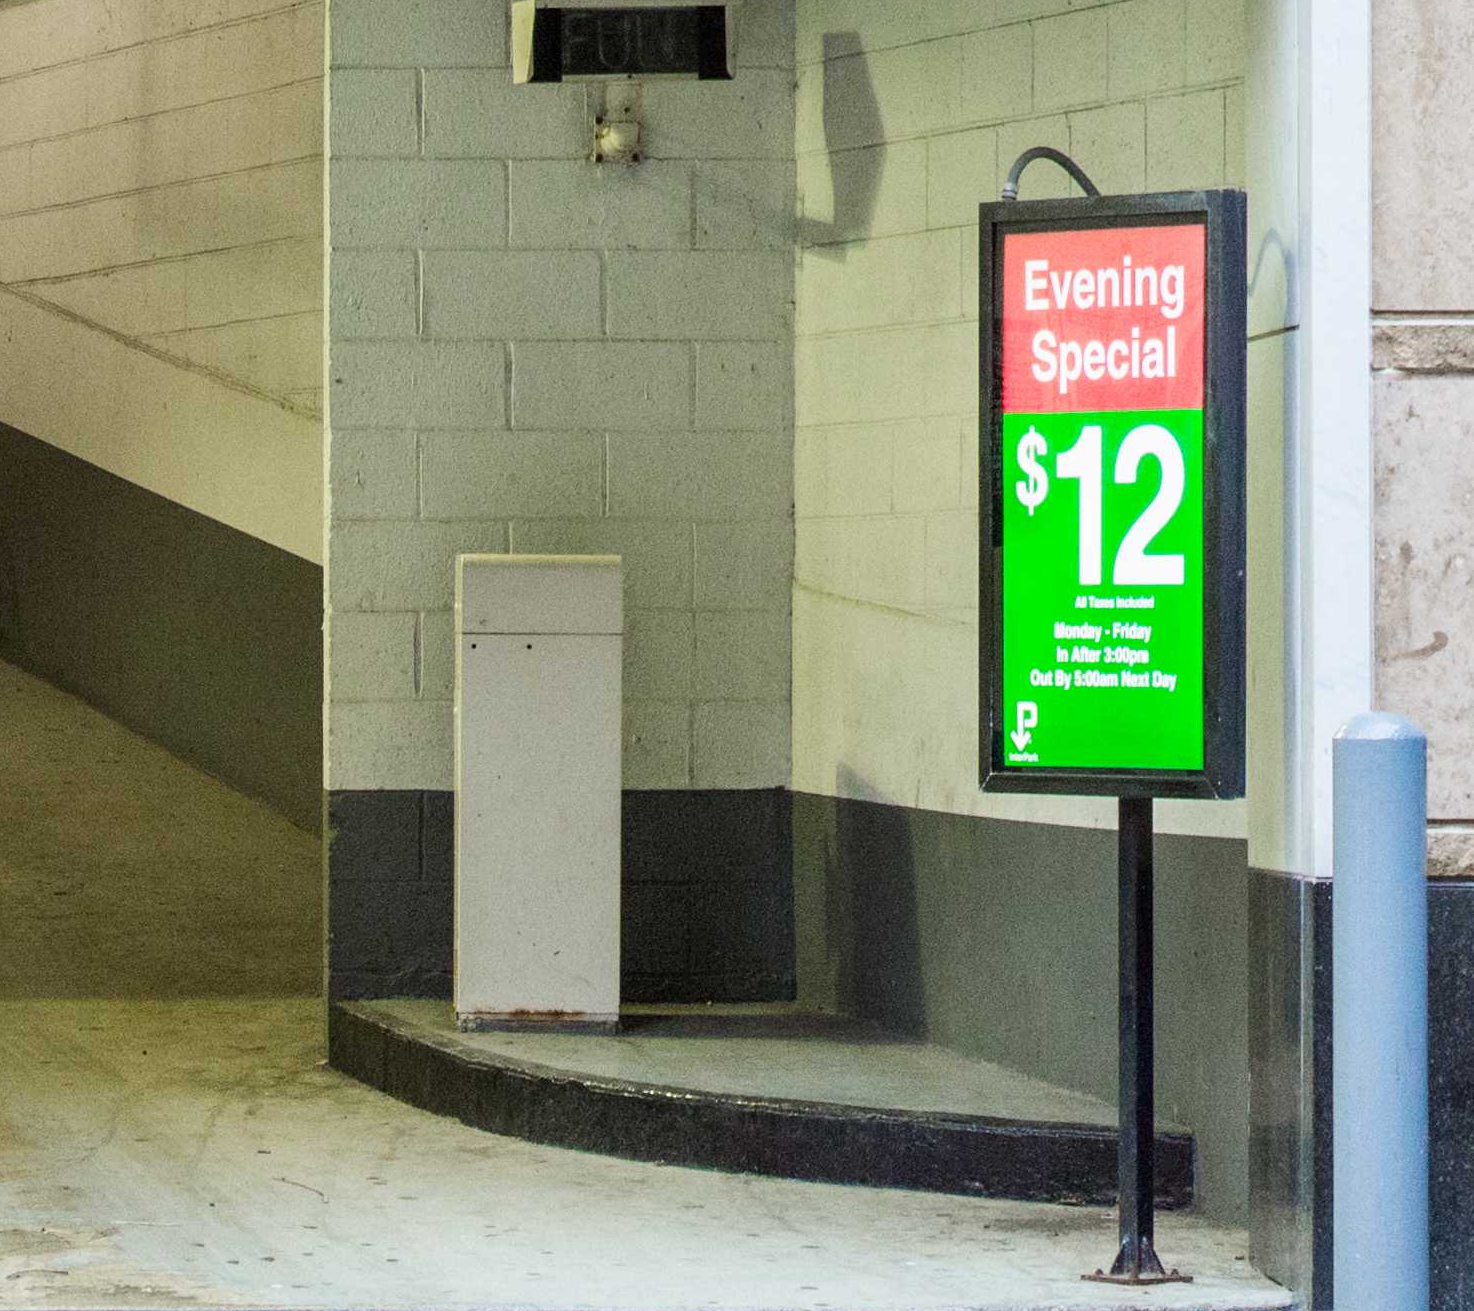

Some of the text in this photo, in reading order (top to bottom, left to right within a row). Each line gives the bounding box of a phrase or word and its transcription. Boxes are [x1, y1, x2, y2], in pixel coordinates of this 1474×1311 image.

[1024, 254, 1185, 319] Evening
[1031, 326, 1177, 394] Special
[1016, 424, 1185, 585] $12
[1116, 595, 1154, 609] Included
[1054, 621, 1102, 642] Monday
[1112, 622, 1152, 643] Friday
[1056, 645, 1149, 667] In After 3:00pm
[1030, 669, 1177, 692] Out By 5:00am Next Day
